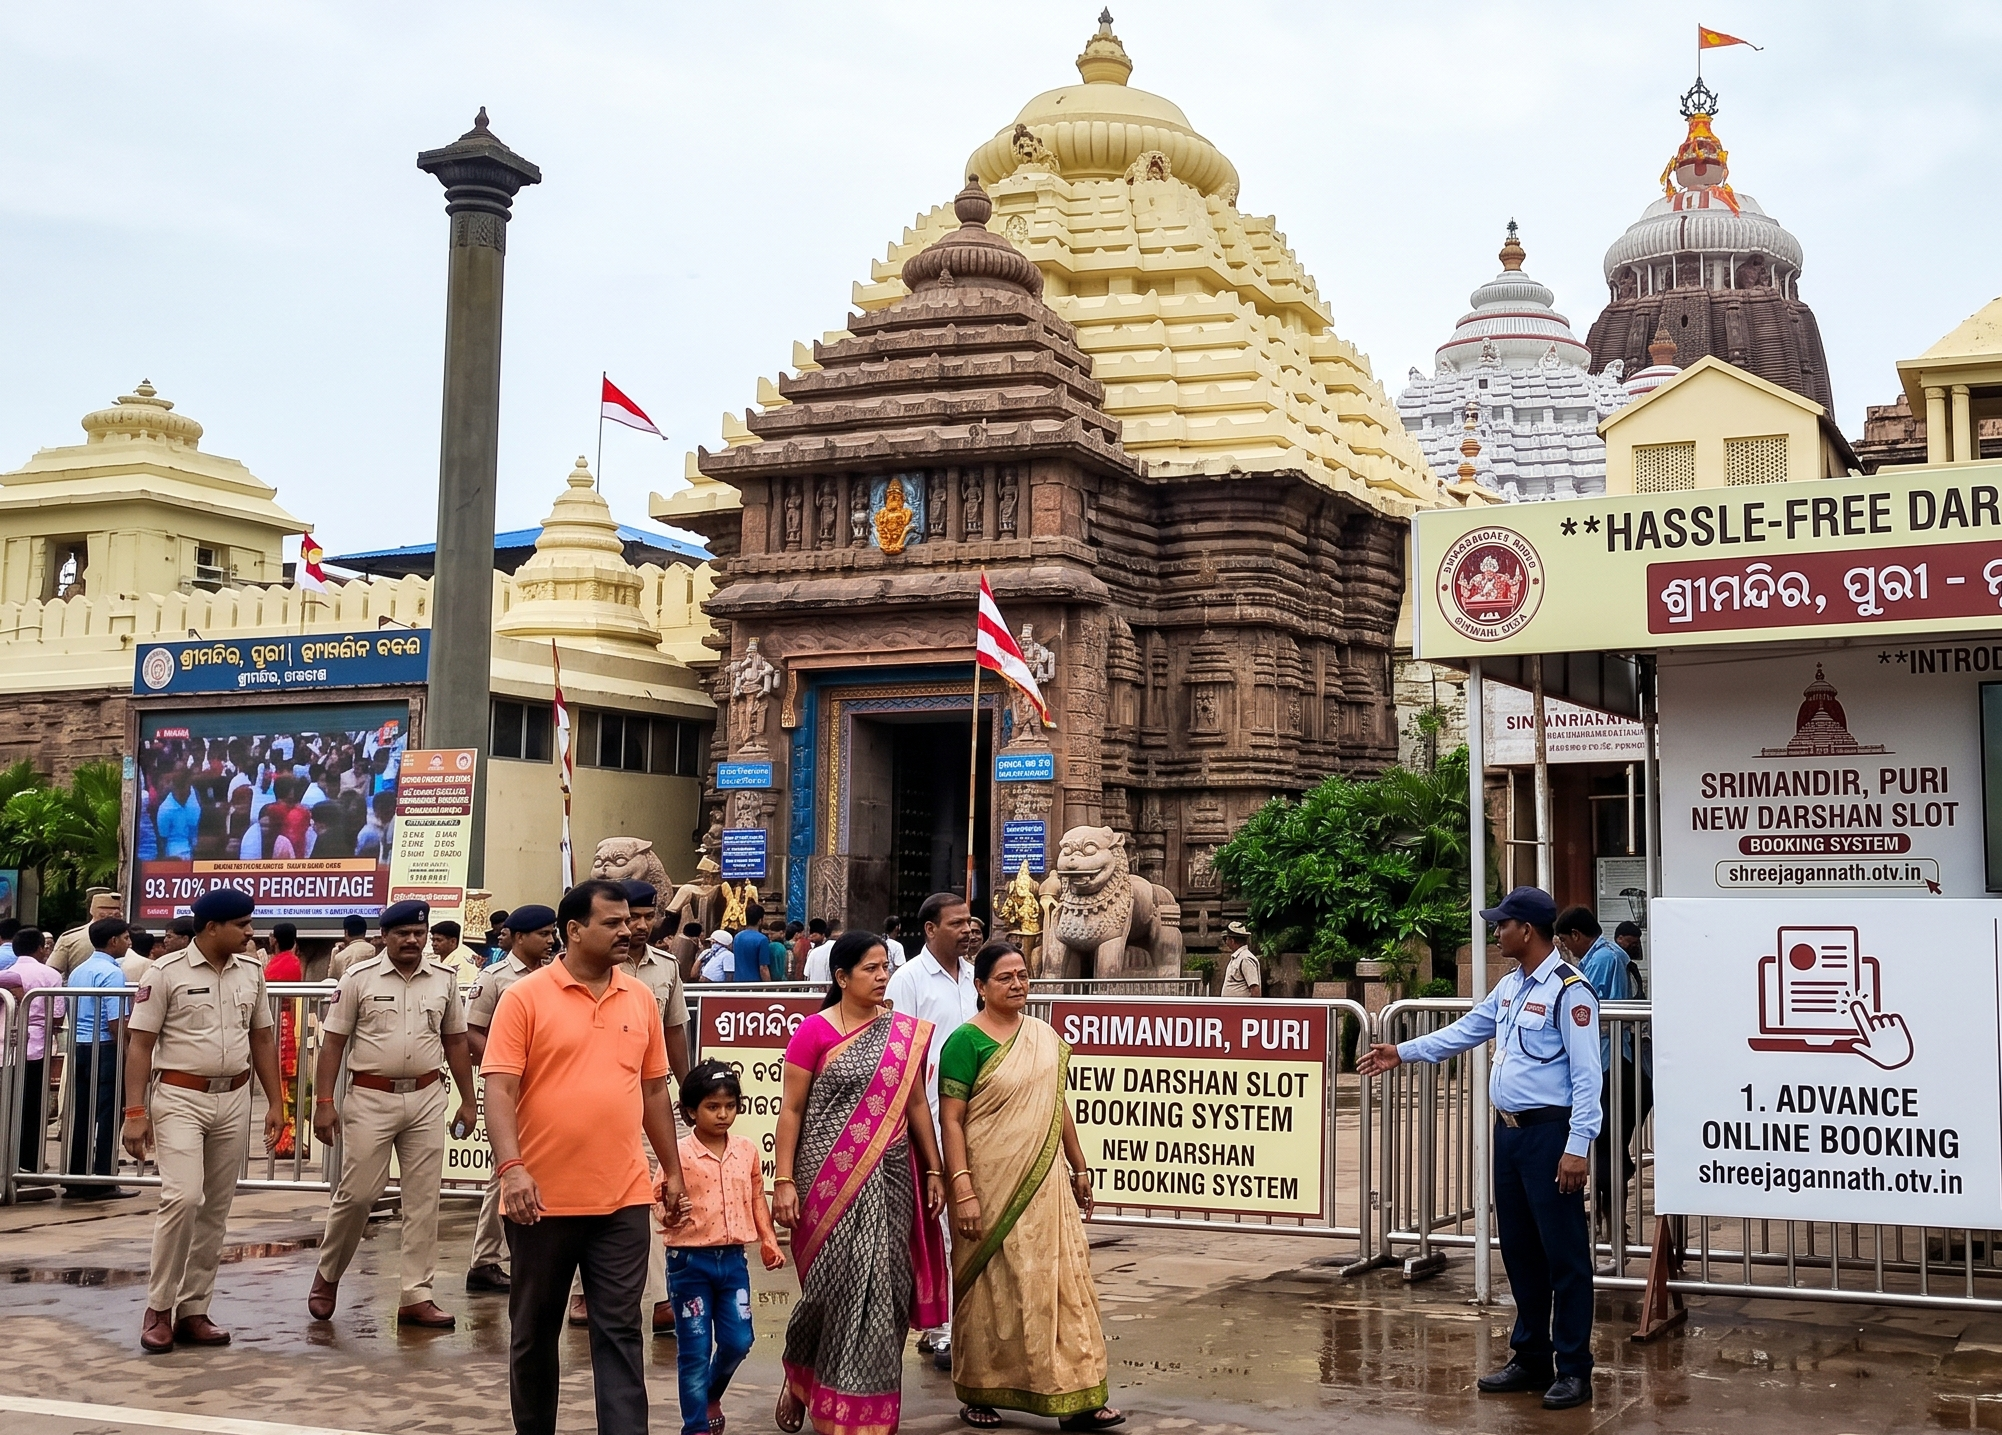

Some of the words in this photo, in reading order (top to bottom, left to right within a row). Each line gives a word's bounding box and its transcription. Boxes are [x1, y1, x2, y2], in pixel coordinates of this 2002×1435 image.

[1908, 485, 2001, 531] DAR
[1843, 563, 1928, 616] ପୁରୀ
[1701, 770, 1869, 799] SRIMANDIR,
[1879, 767, 1948, 795] PURI
[1691, 806, 1749, 831] NEW
[1757, 803, 1882, 830] DARSHAN
[1891, 802, 1960, 828] SLOT
[1750, 837, 1824, 852] BOOKING
[1830, 836, 1899, 851] SYSTEM
[145, 878, 206, 899] 93.70%
[210, 877, 255, 897] PASS
[259, 876, 374, 898] PERCENTAGE
[1729, 863, 1921, 886] shreejagannath.otv.in
[1064, 1015, 1231, 1054] SRIMANDIR,
[1241, 1018, 1310, 1050] PURI
[1066, 1066, 1116, 1092] NEW
[1123, 1067, 1238, 1096] DARSHAN
[1246, 1071, 1309, 1098] SLOT
[1075, 1099, 1183, 1128] BOOKING
[1192, 1102, 1293, 1133] SYSTEM
[1740, 1083, 1766, 1112] 1.
[1776, 1084, 1919, 1117] ADVANCE
[1102, 1138, 1149, 1162] NEW
[1155, 1140, 1255, 1167] DARSHAN
[1702, 1120, 1810, 1153] ONLINE
[1820, 1124, 1960, 1159] BOOKING
[1086, 1168, 1108, 1190] OT
[1113, 1169, 1205, 1196] BOOKING
[1212, 1173, 1298, 1200] SYSTEM
[1698, 1160, 1964, 1195] shreejagannath.otv.in
